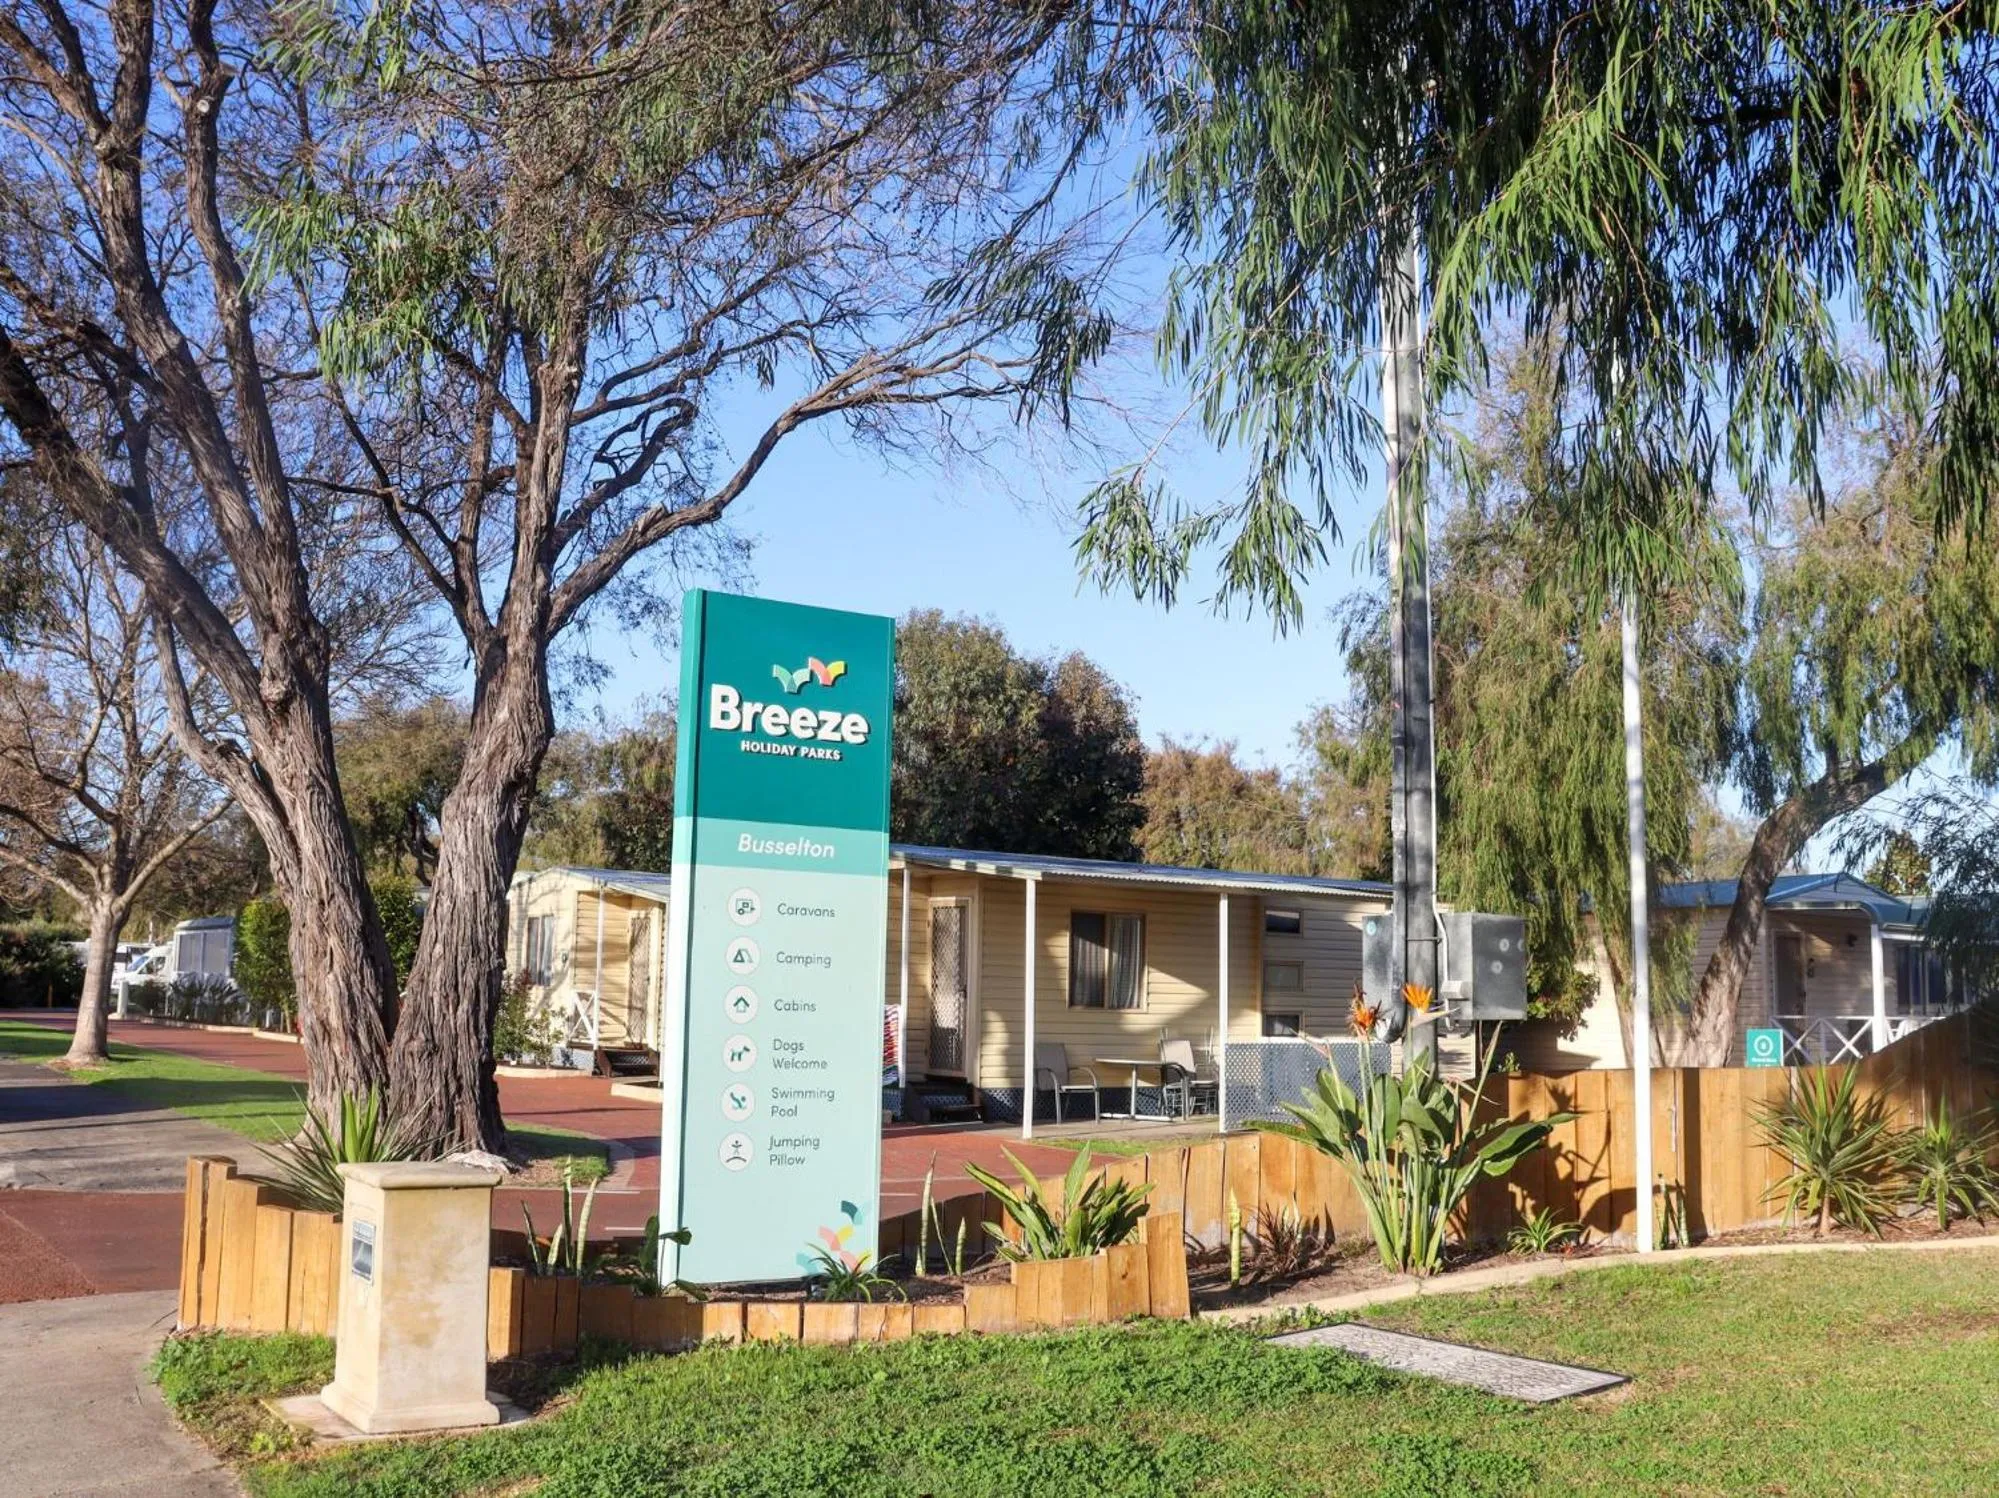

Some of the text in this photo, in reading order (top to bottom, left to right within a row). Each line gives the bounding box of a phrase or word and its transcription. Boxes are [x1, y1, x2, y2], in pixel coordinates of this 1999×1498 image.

[710, 684, 869, 743] Breeze
[741, 741, 842, 761] HOLIDAY PARKS
[738, 834, 836, 859] Busselton
[777, 903, 836, 918] Caravans
[776, 951, 832, 968] Camping
[774, 999, 817, 1012] Cabins
[772, 1038, 805, 1053] Dogs
[772, 1057, 828, 1070] Welcome
[771, 1087, 835, 1102] Swimming
[771, 1105, 798, 1118] Pool
[768, 1134, 821, 1150] Jumping
[769, 1153, 806, 1167] Pillow
